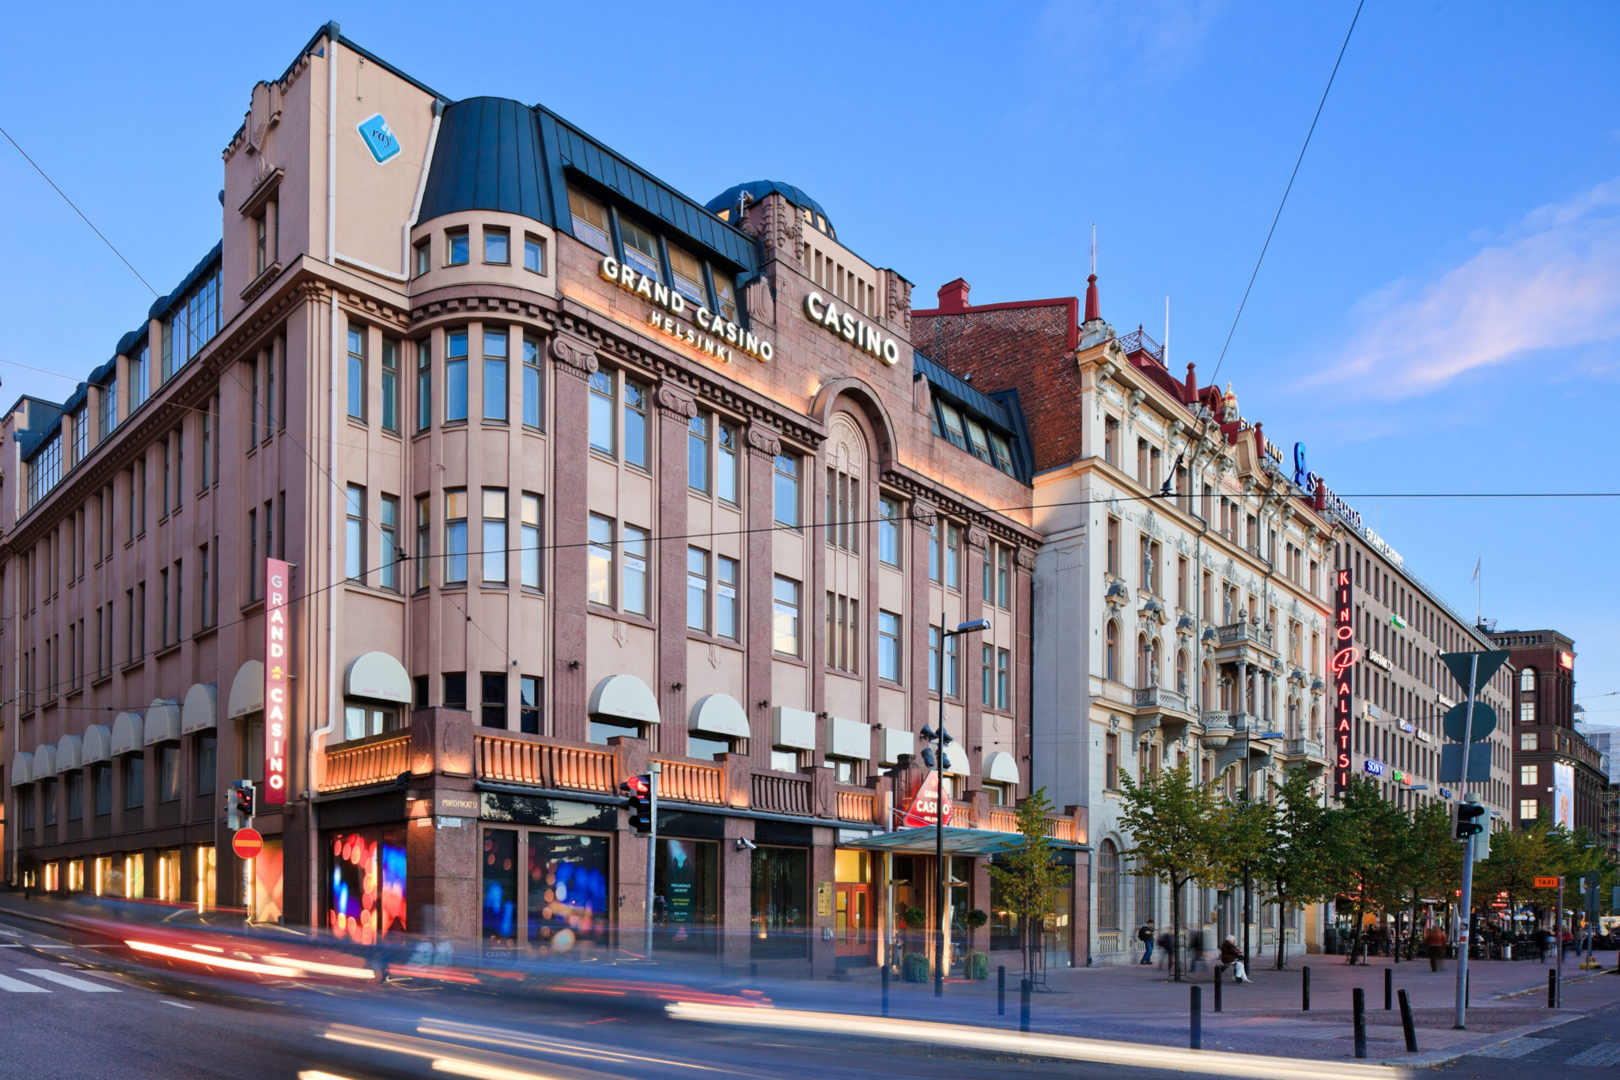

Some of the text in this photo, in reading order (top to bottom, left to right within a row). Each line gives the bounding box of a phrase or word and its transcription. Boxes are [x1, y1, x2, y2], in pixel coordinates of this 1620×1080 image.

[372, 129, 392, 148] ray
[602, 256, 774, 362] GRAND CASINO
[805, 291, 900, 366] CASINO
[650, 311, 732, 364] HELSINKI
[269, 574, 284, 790] GRAND CASINO
[1331, 571, 1359, 787] KINO PALATSI
[1367, 759, 1384, 776] SONY
[442, 799, 478, 810] MIKONKATU
[916, 800, 950, 815] CASIO
